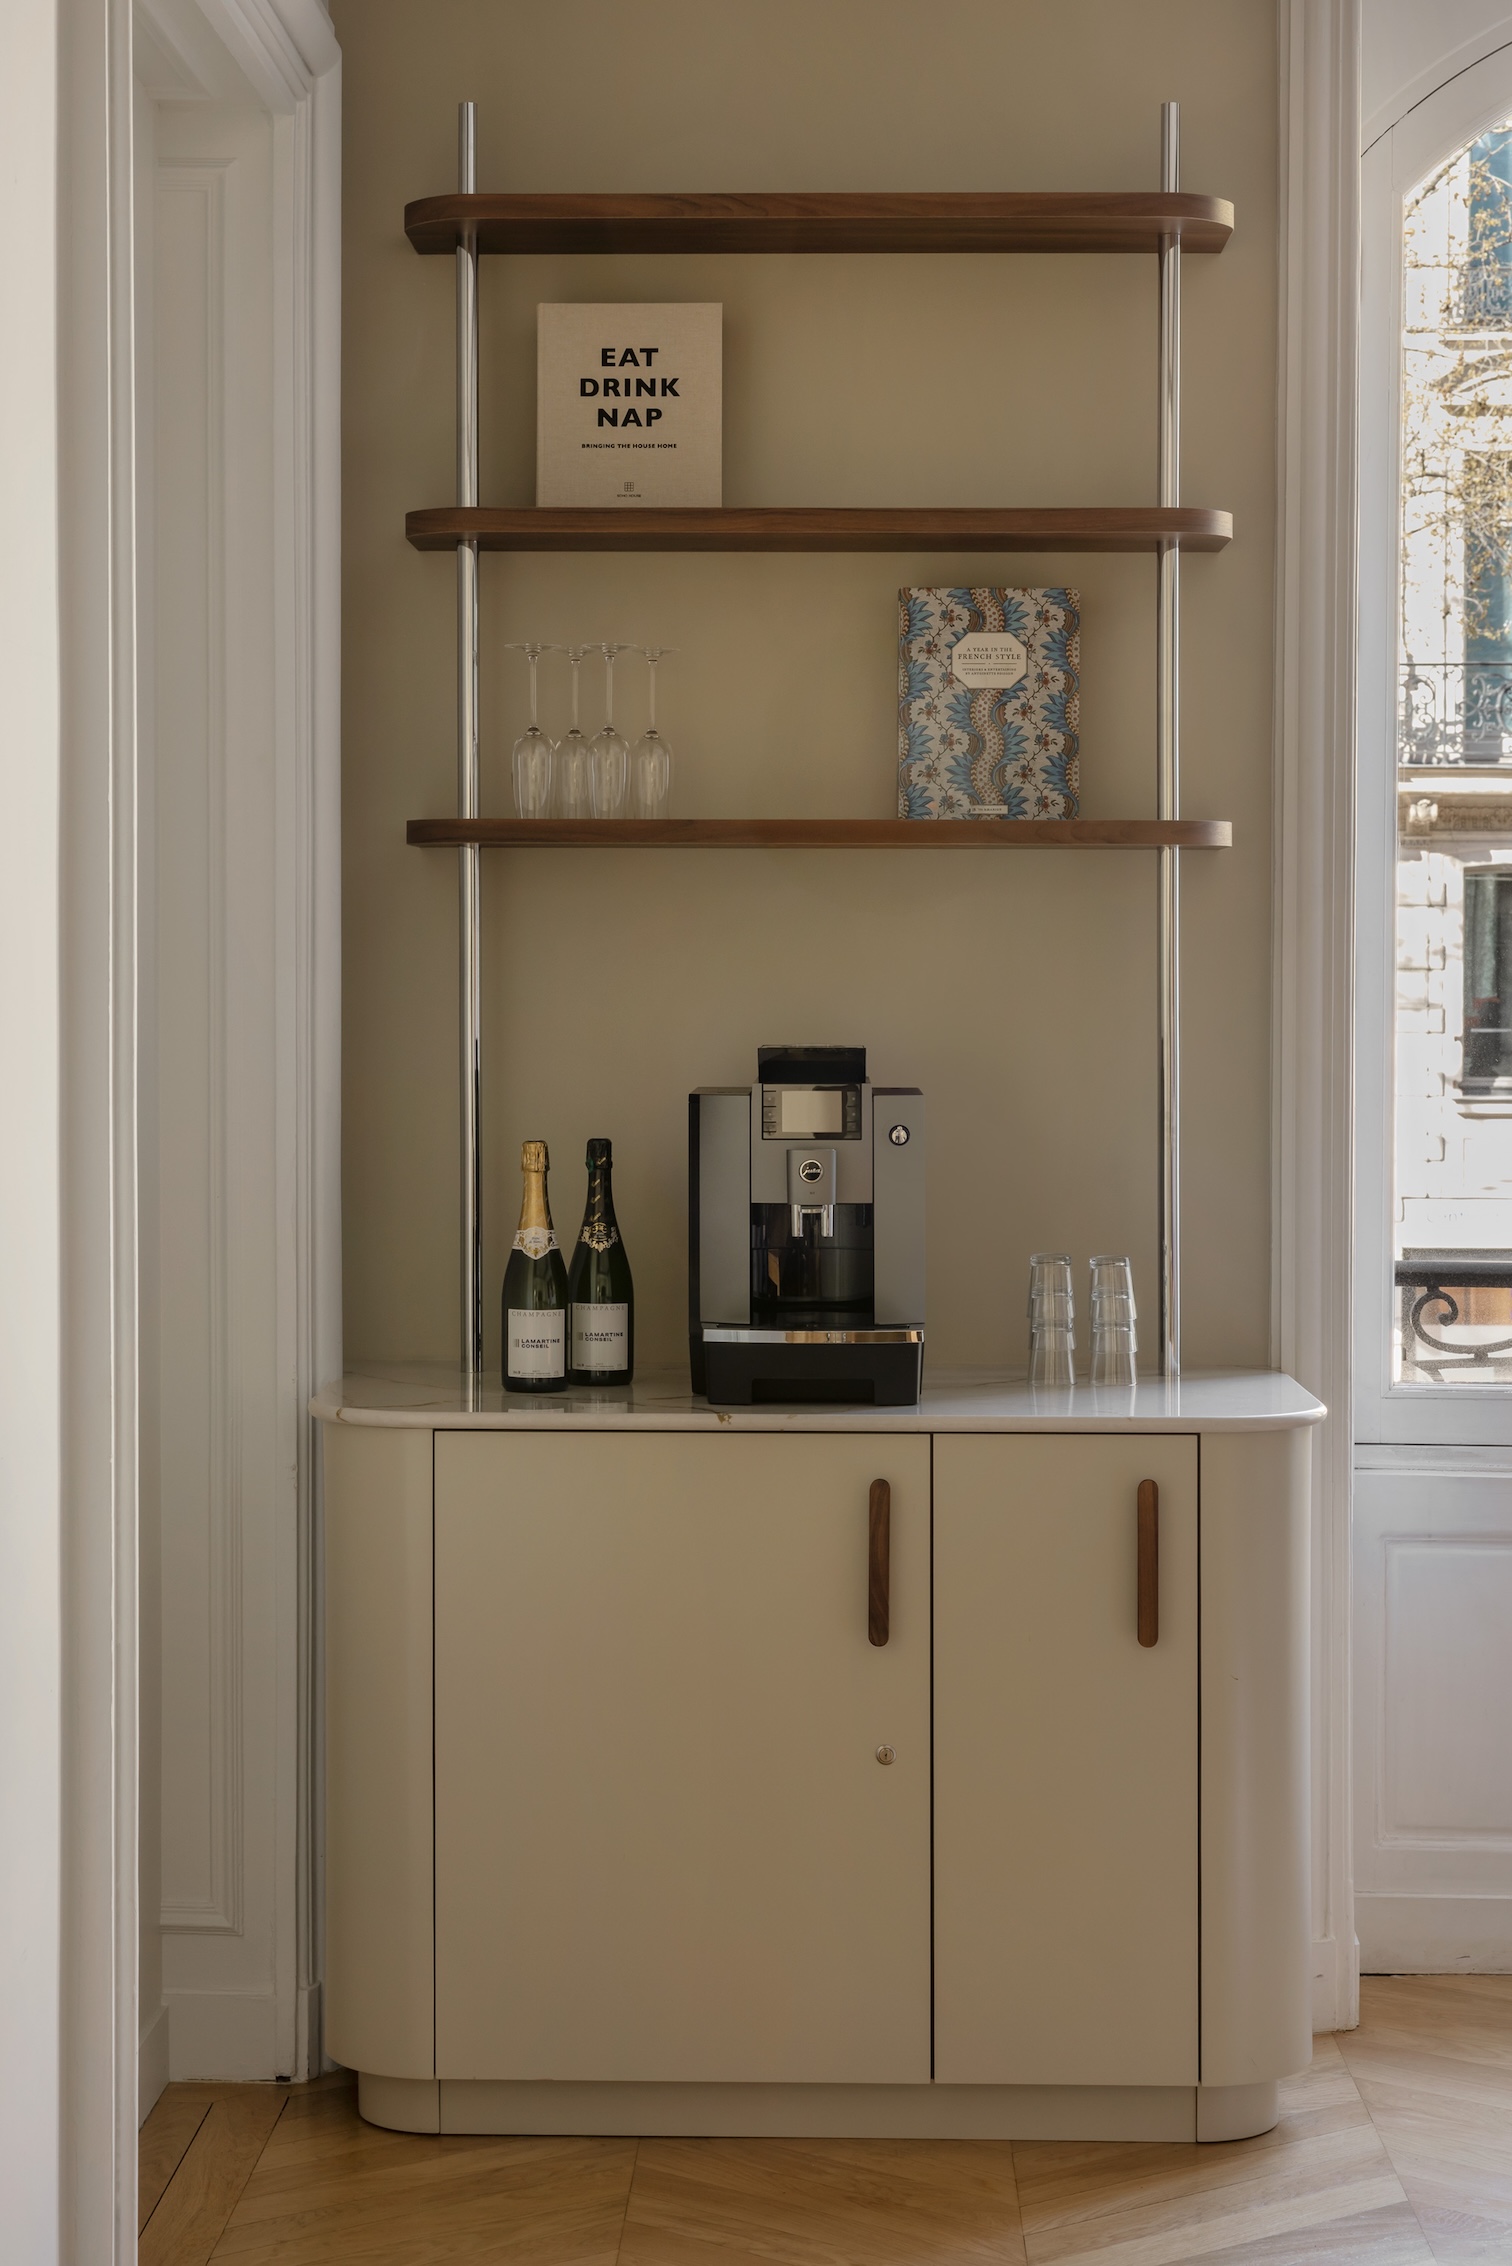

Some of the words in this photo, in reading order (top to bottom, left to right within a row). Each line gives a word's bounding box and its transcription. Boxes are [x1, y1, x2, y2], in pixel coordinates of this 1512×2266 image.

[601, 348, 659, 367] EAT
[580, 378, 680, 397] DRINK
[597, 408, 663, 427] NAP
